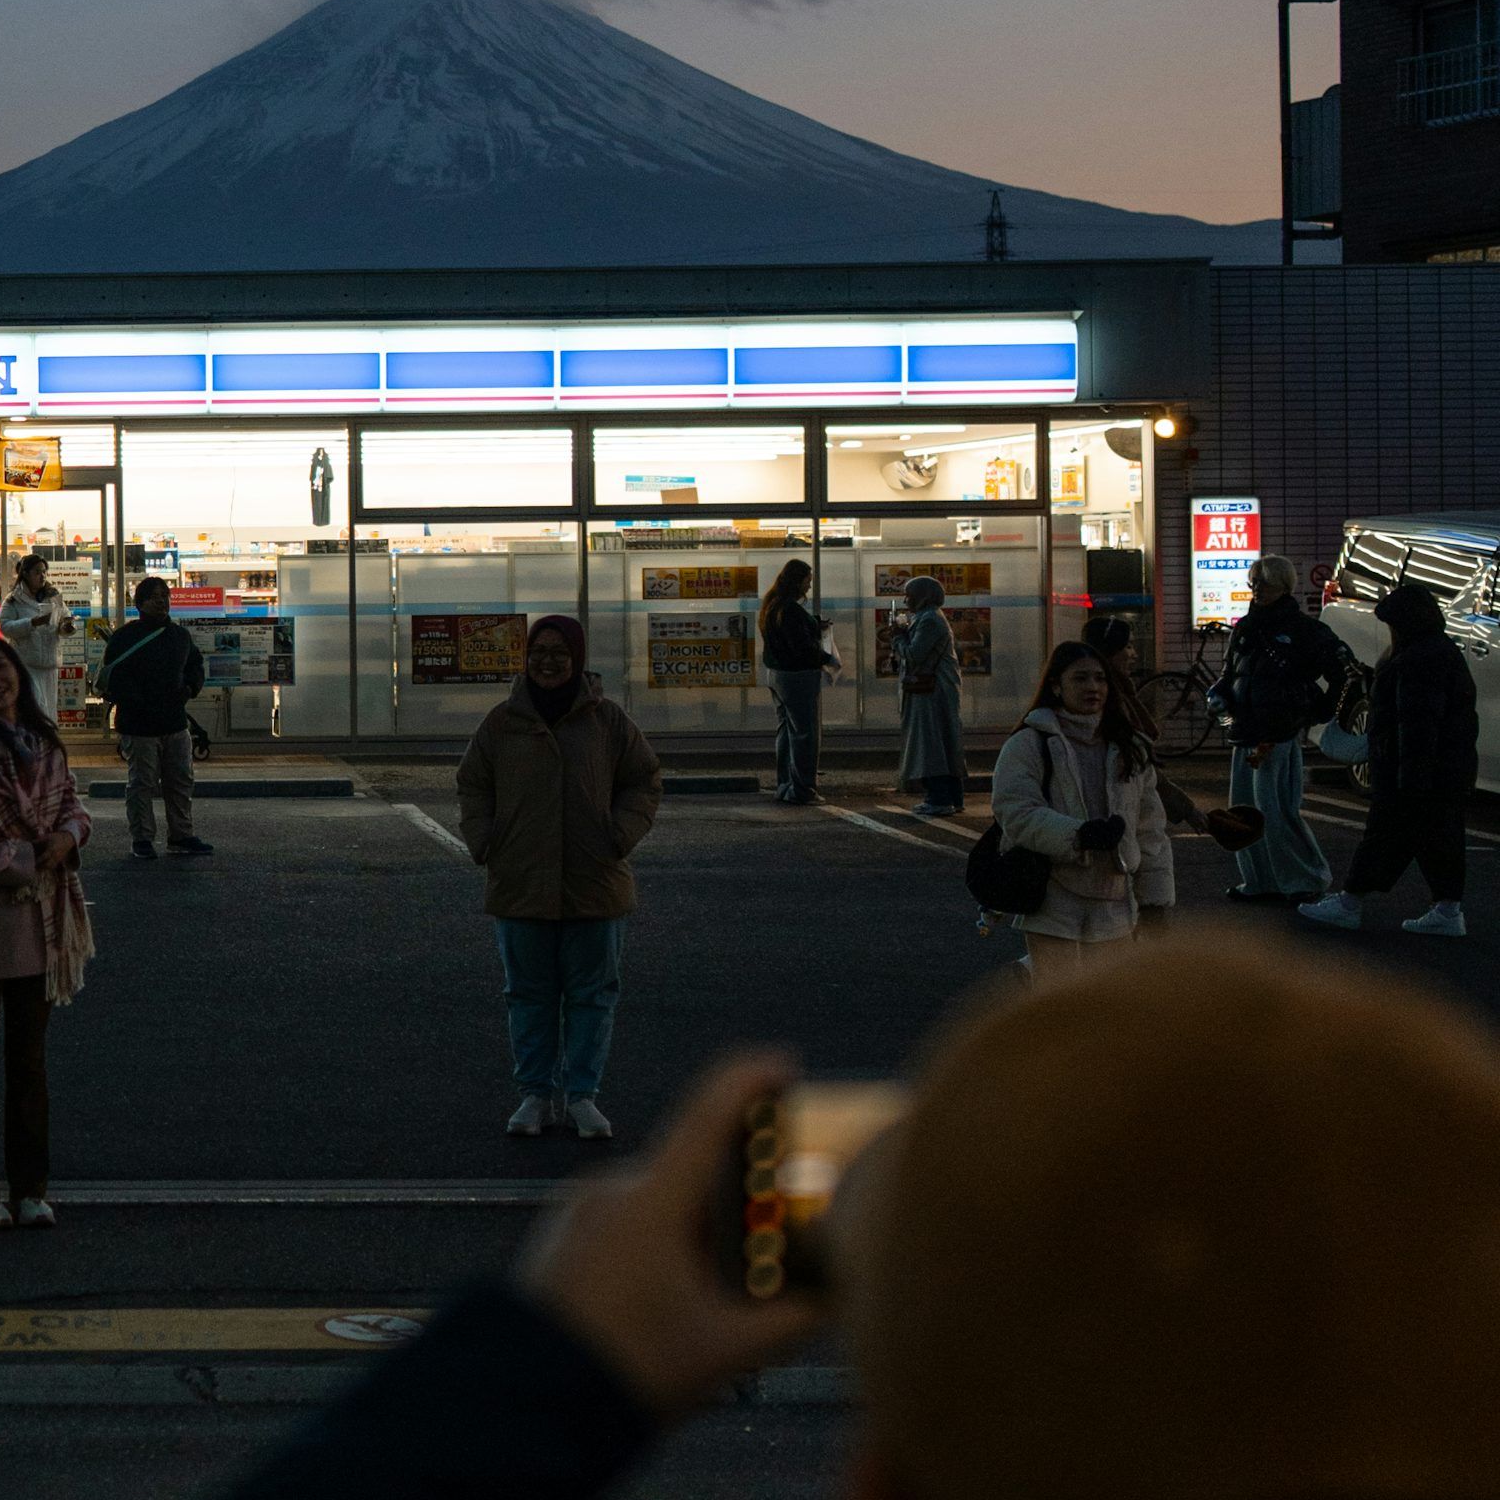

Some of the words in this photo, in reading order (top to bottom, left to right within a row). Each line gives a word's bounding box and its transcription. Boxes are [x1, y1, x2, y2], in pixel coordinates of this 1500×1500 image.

[1204, 503, 1251, 512] ATMサービス
[1209, 517, 1247, 533] 銀行
[1205, 533, 1248, 549] ATM
[670, 645, 721, 656] MONEY
[653, 660, 751, 675] EXCHANGE
